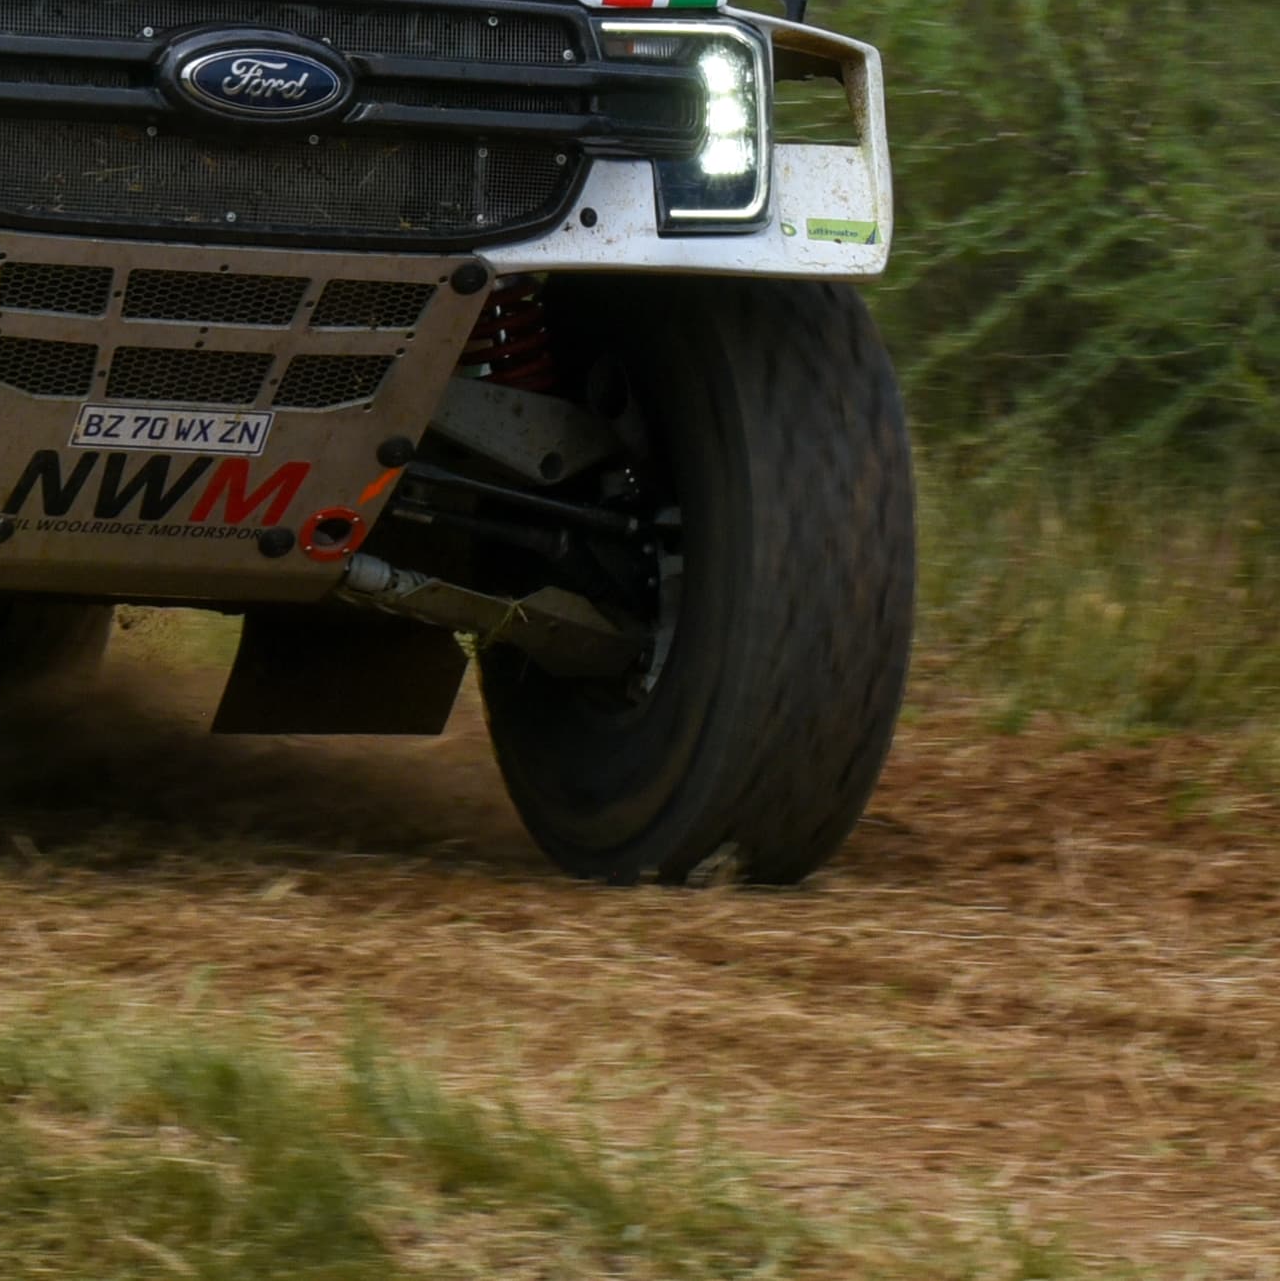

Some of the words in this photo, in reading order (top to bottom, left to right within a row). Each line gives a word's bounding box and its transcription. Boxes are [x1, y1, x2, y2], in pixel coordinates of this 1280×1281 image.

[222, 58, 309, 100] Ford
[807, 227, 858, 237] ultimate
[83, 413, 126, 439] BZ
[131, 417, 170, 440] 70
[174, 419, 215, 443] WX
[218, 421, 261, 445] ZN
[0, 449, 312, 527] NWM
[37, 519, 145, 535] WOOLRIDGE
[148, 524, 264, 541] MOTORSPOR
